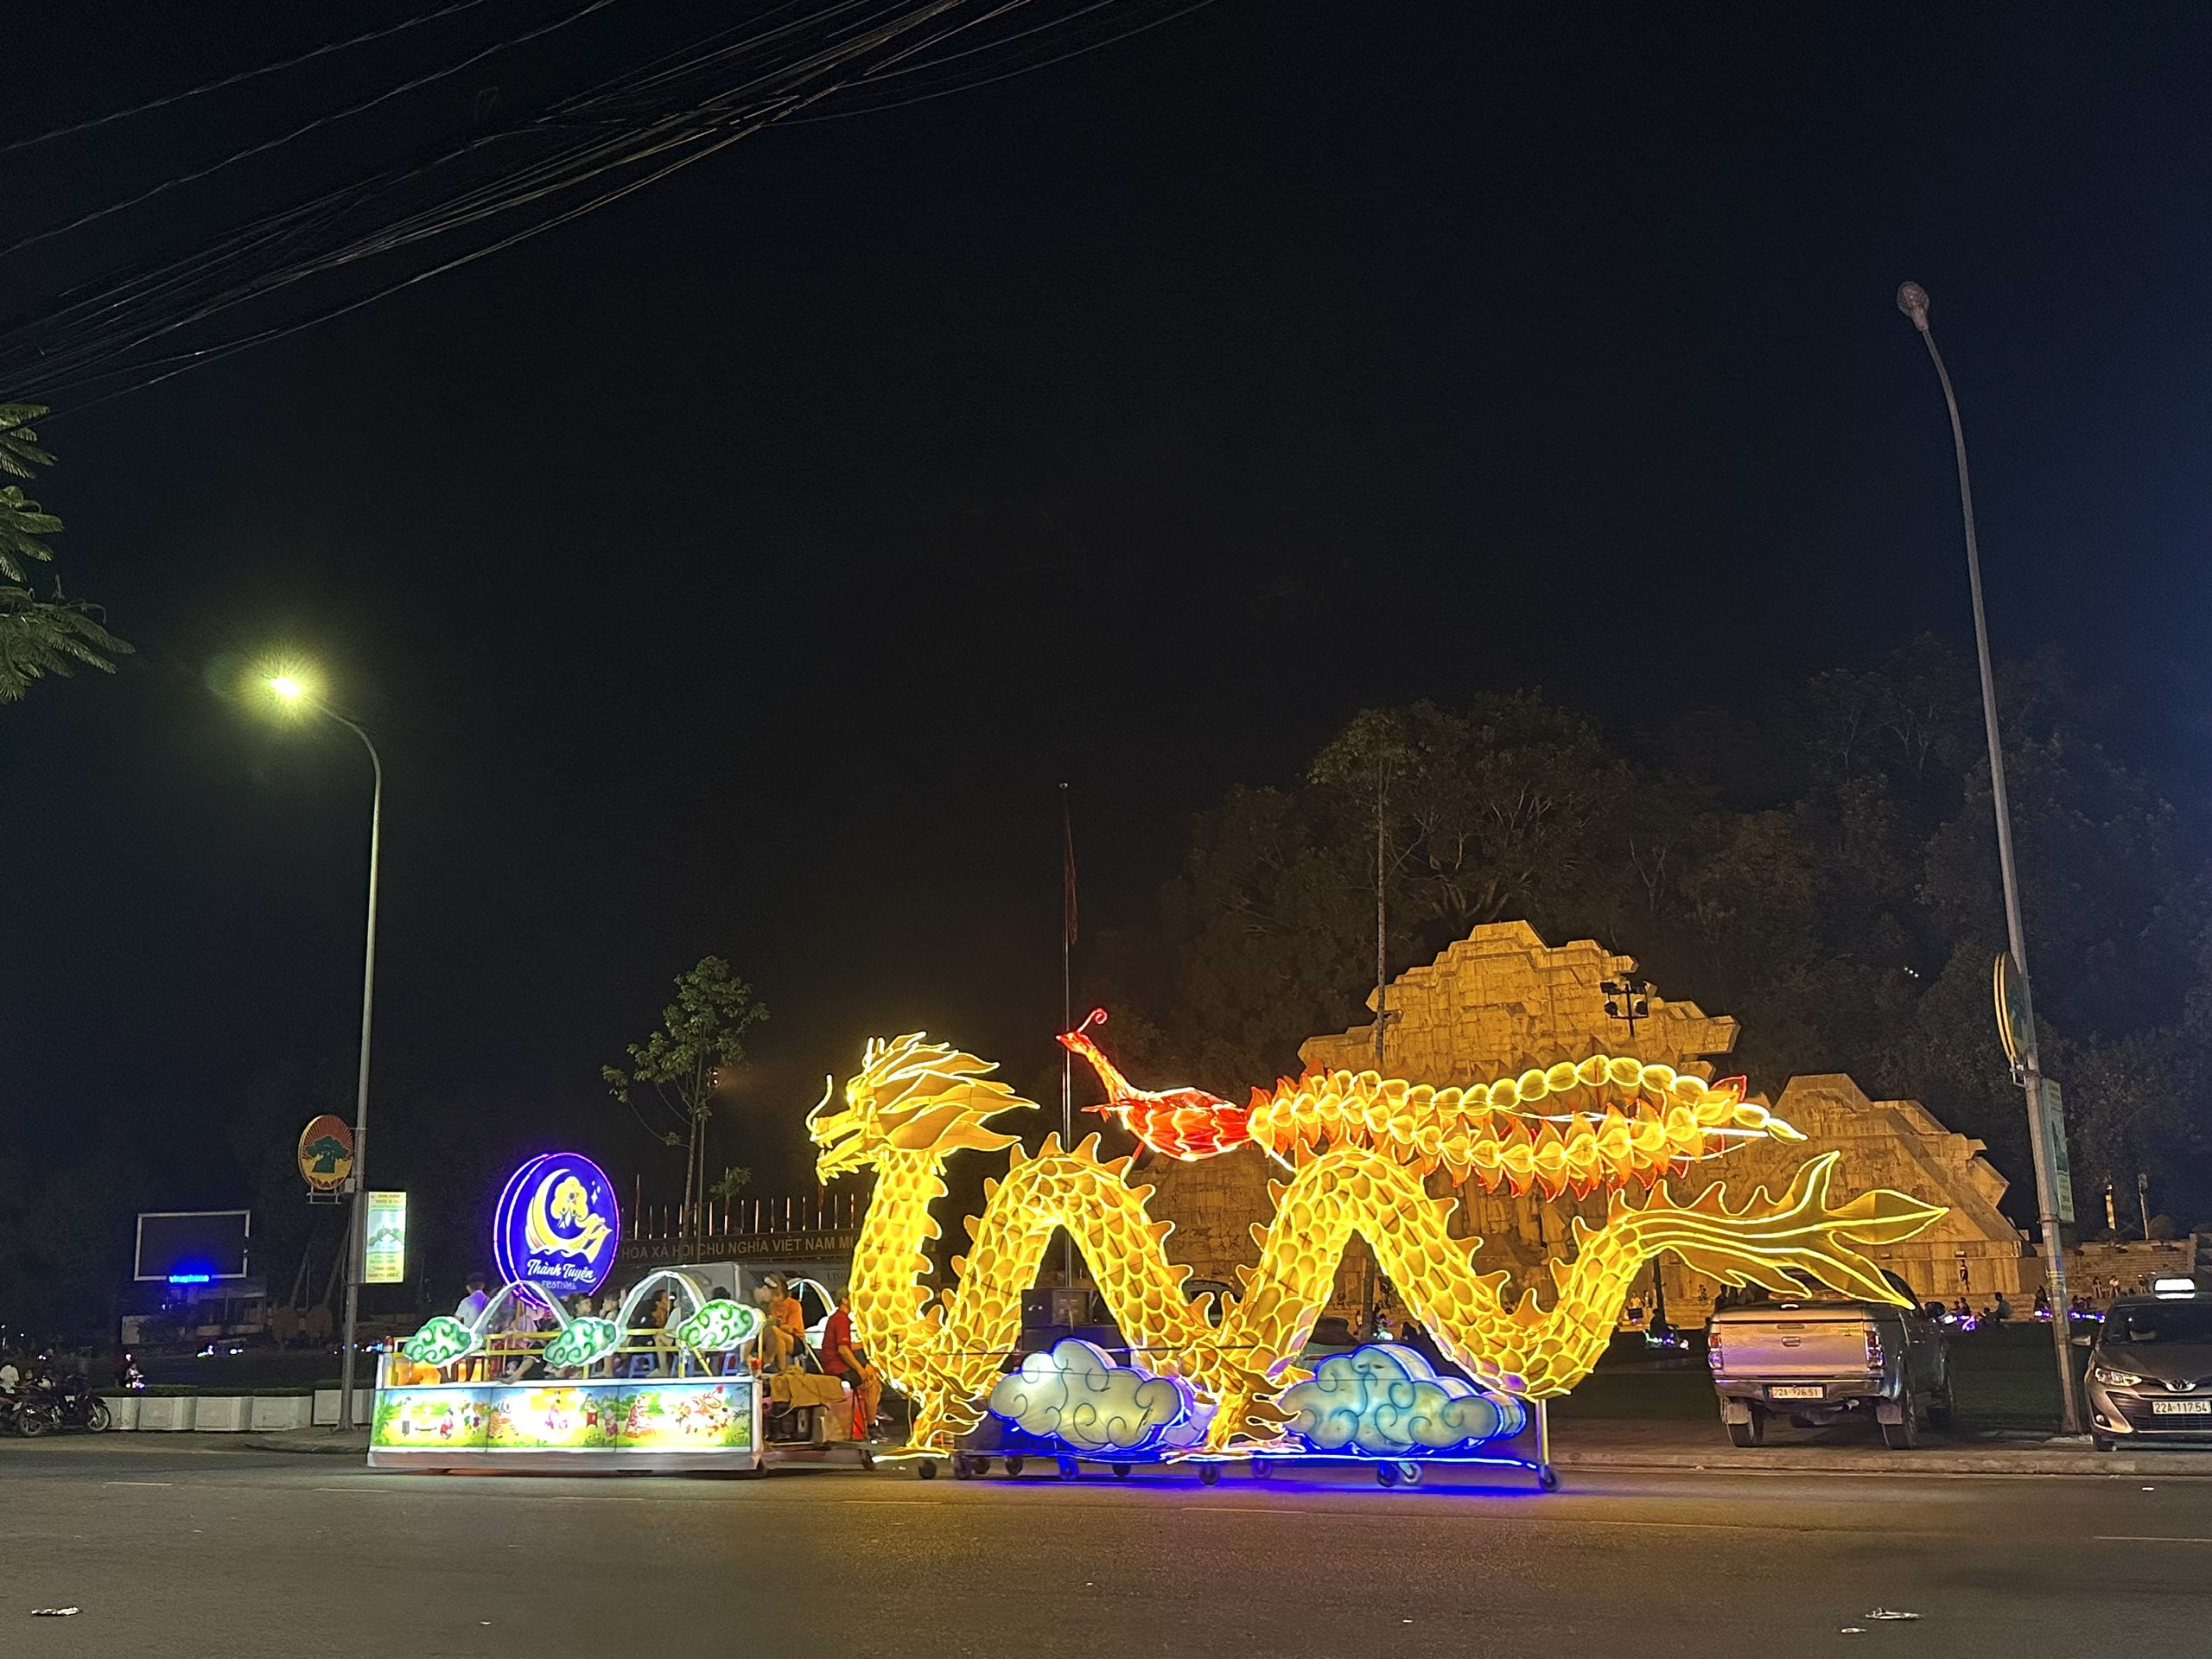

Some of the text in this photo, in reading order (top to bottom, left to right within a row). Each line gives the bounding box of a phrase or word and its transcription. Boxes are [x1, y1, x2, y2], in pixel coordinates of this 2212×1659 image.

[728, 1237, 769, 1254] NGHĨA
[772, 1236, 802, 1255] VIỆT
[805, 1236, 835, 1250] NAM
[527, 1259, 596, 1283] Thành Tuyên
